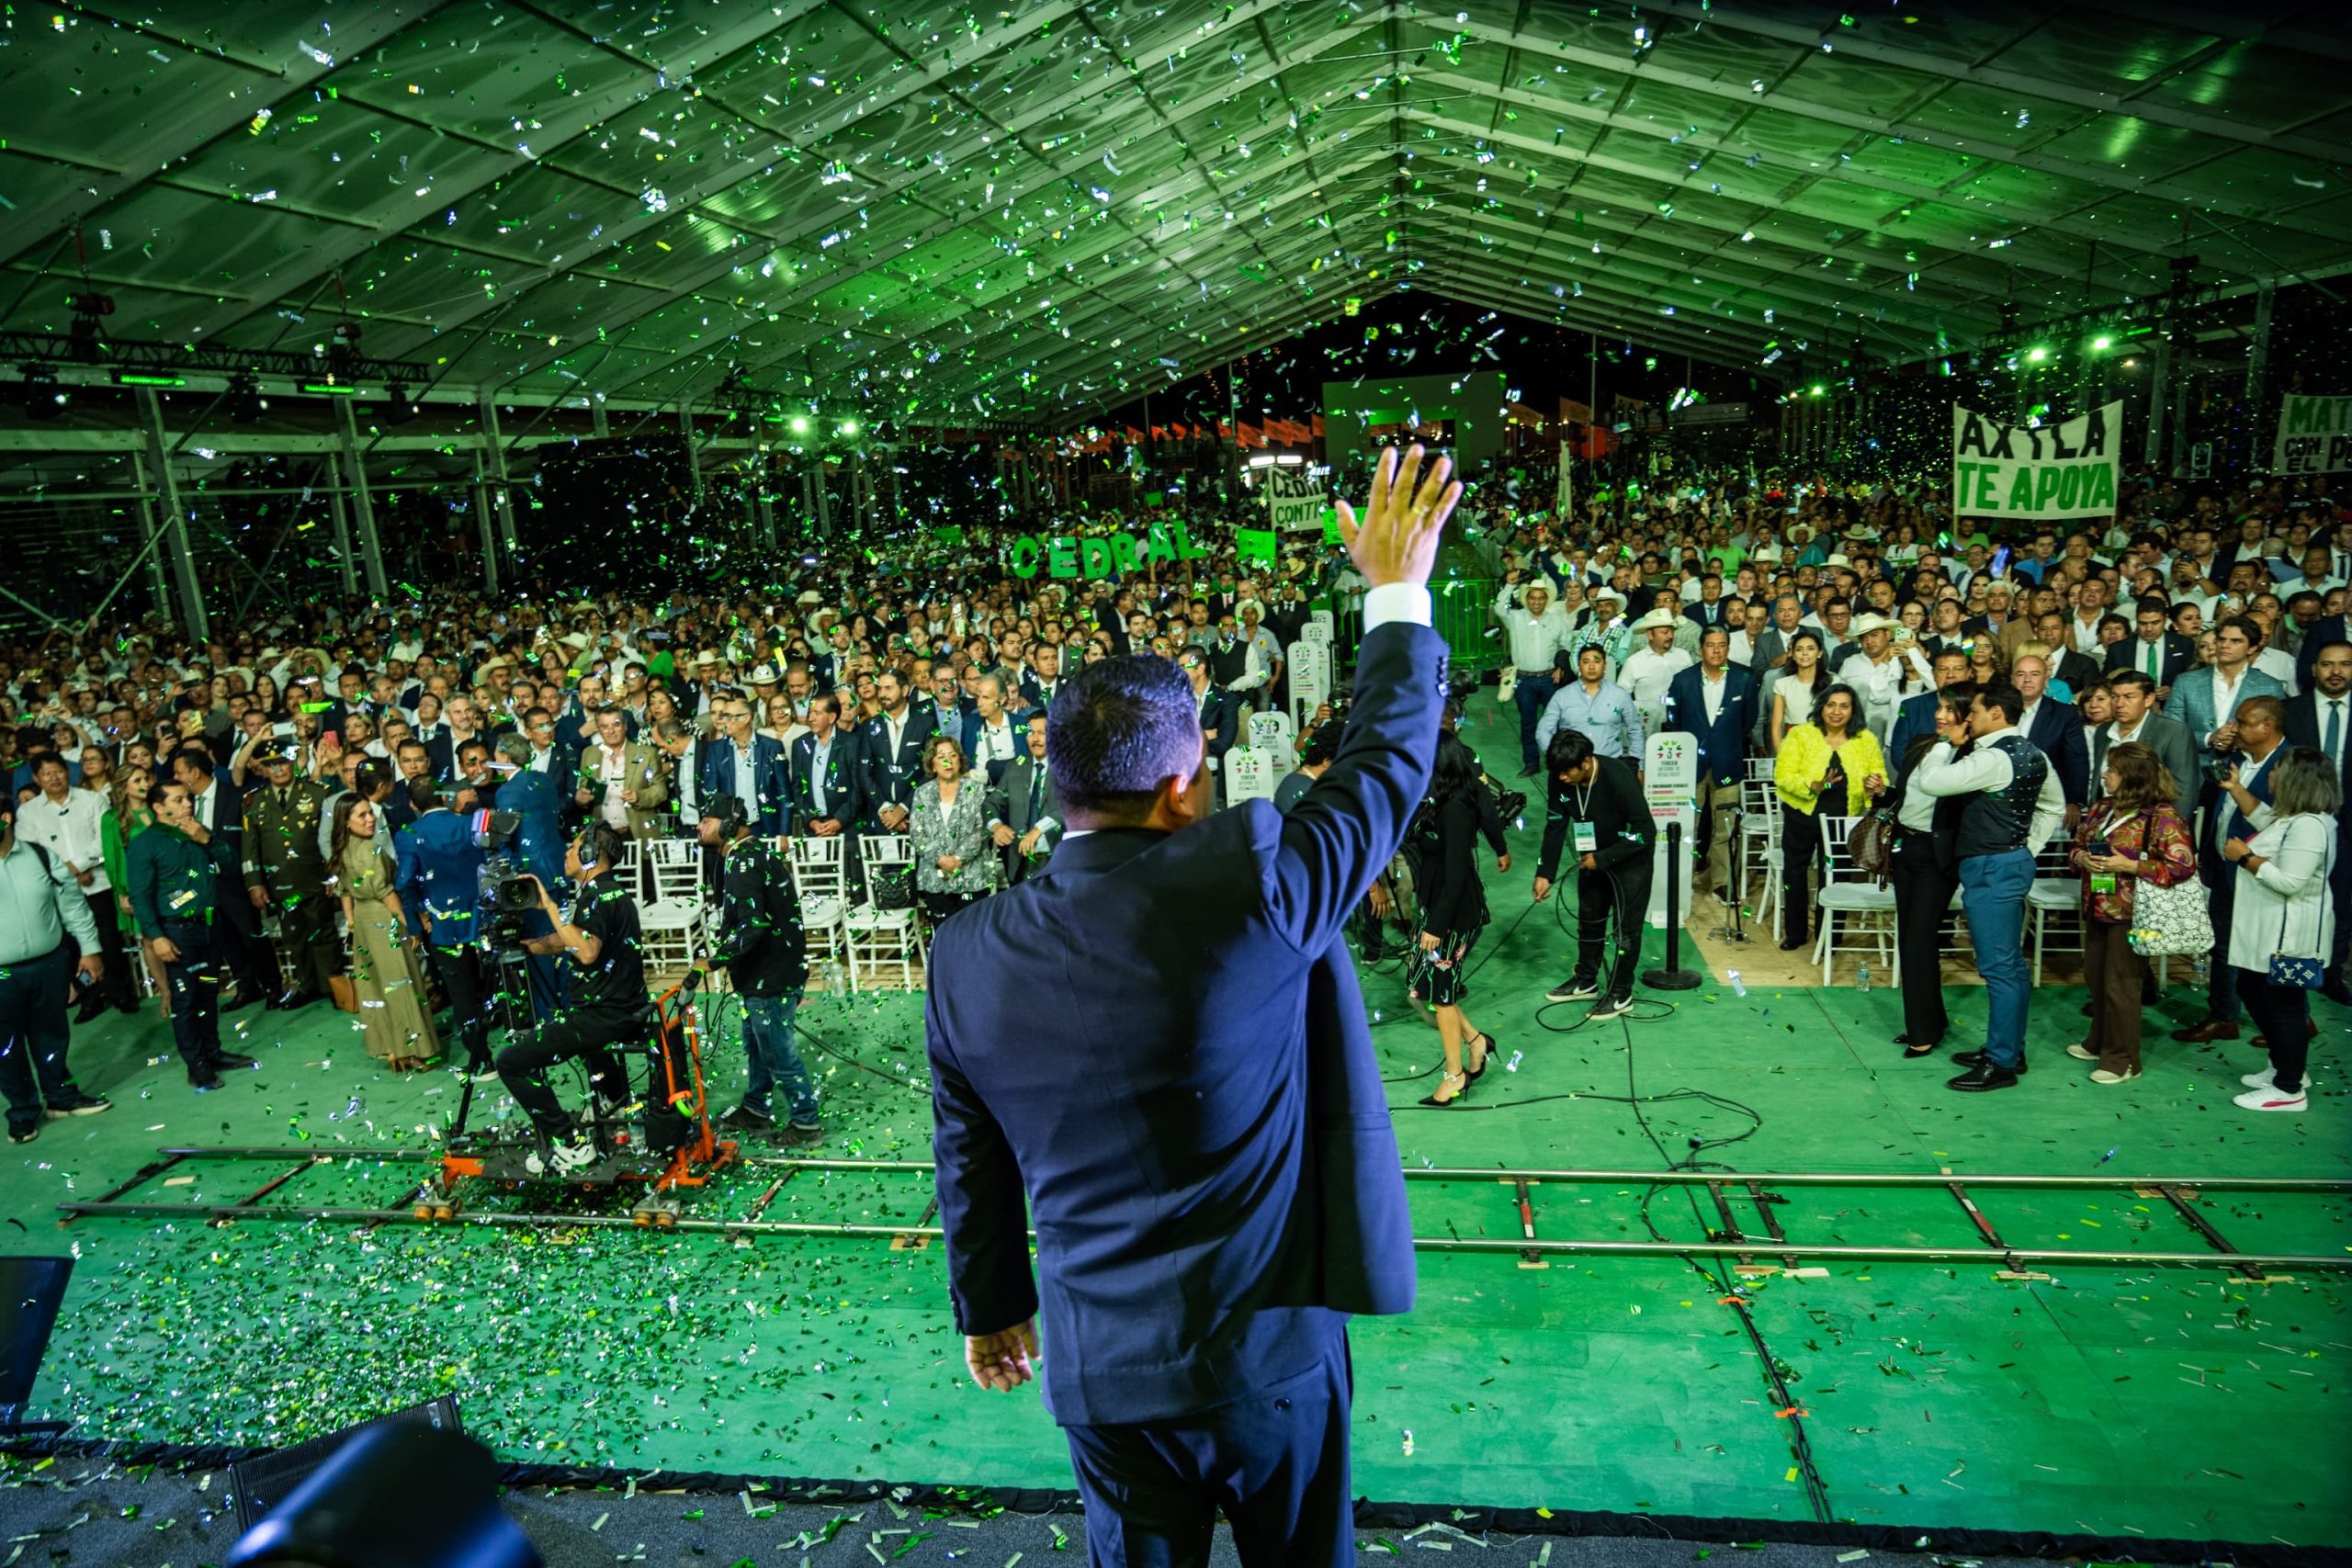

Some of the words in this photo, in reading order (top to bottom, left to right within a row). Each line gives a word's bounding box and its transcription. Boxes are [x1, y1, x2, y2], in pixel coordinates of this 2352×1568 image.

[1959, 410, 2106, 460] AXTLA
[2285, 436, 2322, 457] CON
[1958, 462, 1999, 510] TE
[2008, 463, 2114, 511] APOYA
[2287, 457, 2317, 472] EL
[1012, 520, 1207, 580] CEDRAL
